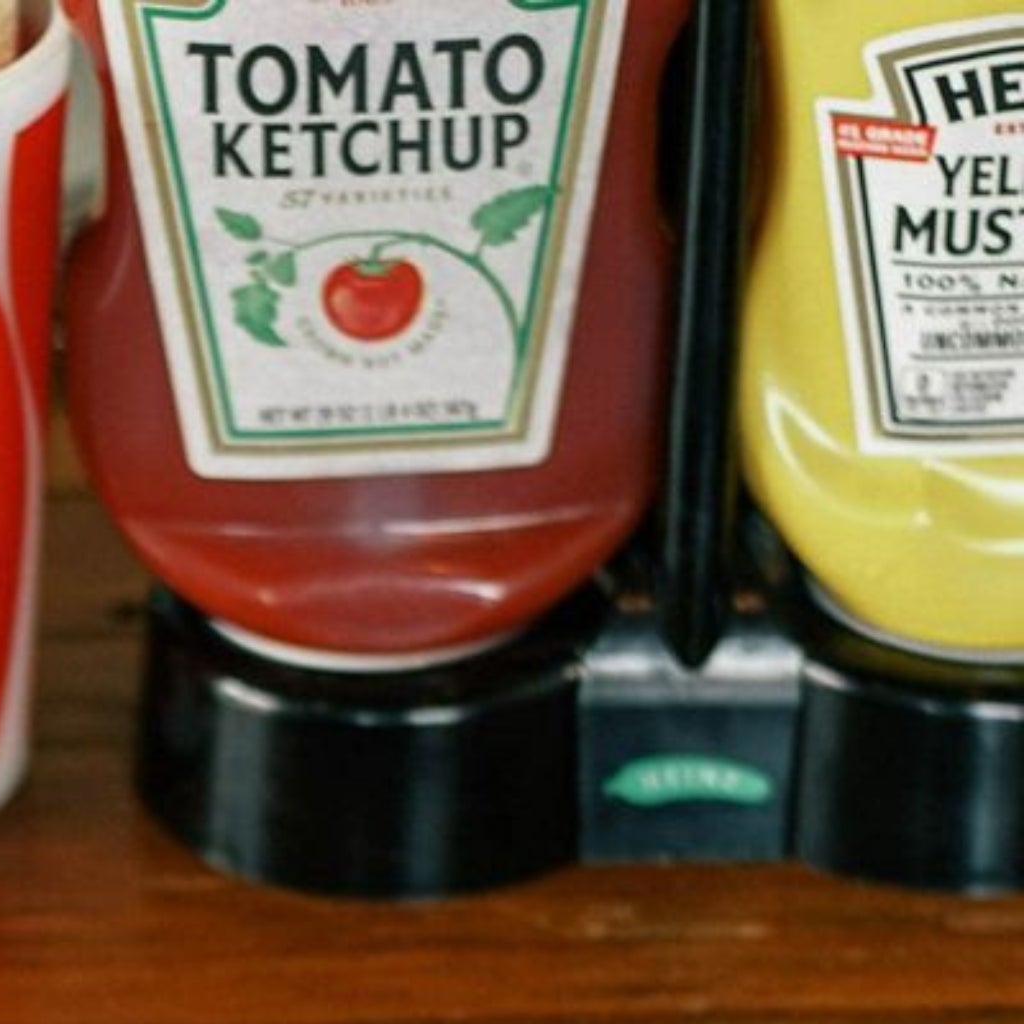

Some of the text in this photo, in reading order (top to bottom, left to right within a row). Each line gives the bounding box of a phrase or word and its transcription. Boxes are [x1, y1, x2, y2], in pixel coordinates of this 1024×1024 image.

[187, 33, 545, 116] TOMATO
[212, 112, 532, 178] KETCHUP
[321, 185, 451, 205] VARIETIES
[893, 204, 1024, 257] MUS
